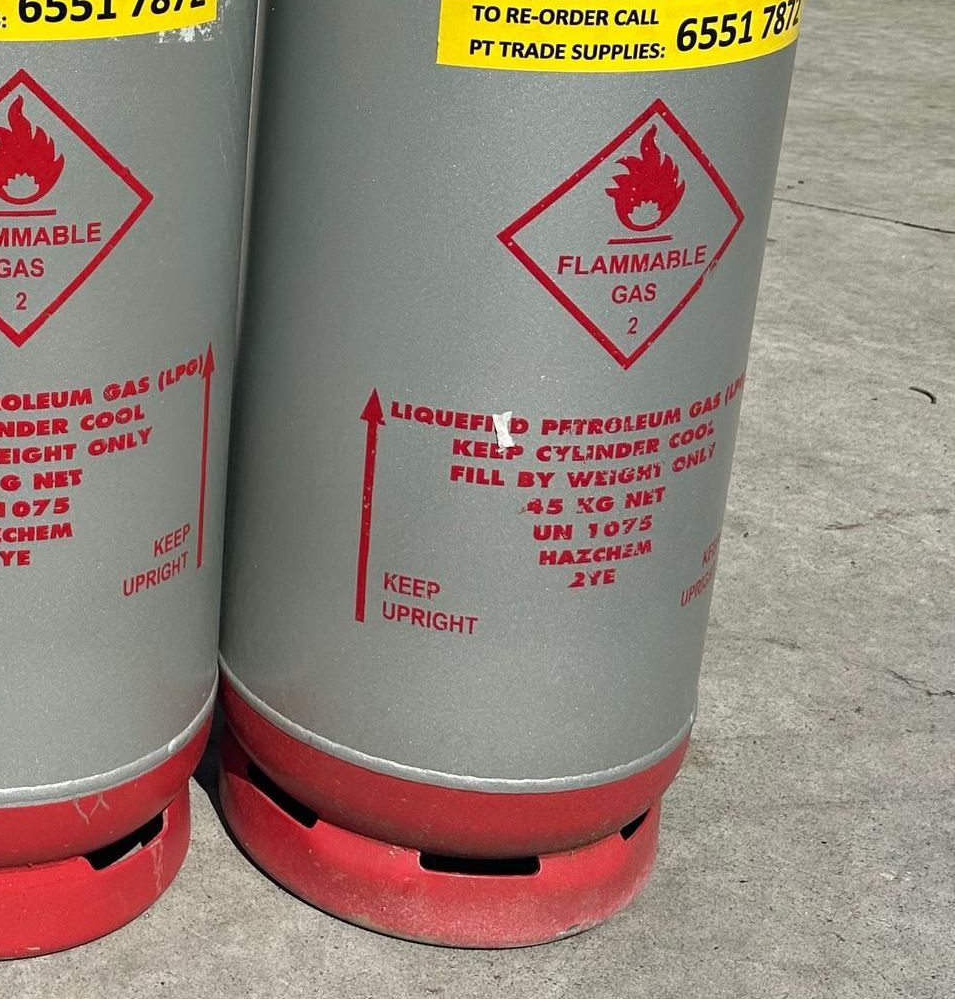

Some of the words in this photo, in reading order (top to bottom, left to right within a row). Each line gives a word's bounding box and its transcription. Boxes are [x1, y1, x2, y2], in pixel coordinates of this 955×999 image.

[472, 4, 501, 23] TO
[506, 6, 608, 27] RE-ORDER
[613, 8, 659, 25] CALL
[676, 9, 753, 51] 6551
[469, 39, 496, 56] PT
[499, 41, 566, 60] TRADE
[571, 42, 666, 61] SUPPLIES:
[557, 245, 707, 275] FLAMMABLE
[15, 291, 27, 311] 2
[611, 283, 657, 304] GAS
[627, 317, 638, 335] 2
[102, 375, 150, 401] GAS
[158, 354, 204, 392] (LPG)
[79, 404, 145, 431] COOL
[390, 401, 531, 435] LIQUEFID
[689, 391, 721, 418] GAS
[87, 425, 154, 457] ONLY
[536, 435, 660, 463] CYLINDER
[449, 464, 505, 487] FILL
[517, 470, 555, 488] BY
[567, 465, 663, 489] WEIGHT
[671, 440, 717, 473] ONLY
[33, 469, 83, 491] NET
[526, 498, 563, 515] 45
[576, 497, 615, 515] KG
[624, 486, 666, 510] NET
[153, 523, 191, 557] KEEP
[533, 522, 573, 542] UN
[588, 514, 653, 539] 1075
[539, 537, 653, 566] HAZCHEM
[123, 551, 189, 597] UPRIGHT
[383, 571, 441, 599] KEEP
[567, 568, 618, 589] 2YE
[382, 599, 479, 636] UPRIGHT
